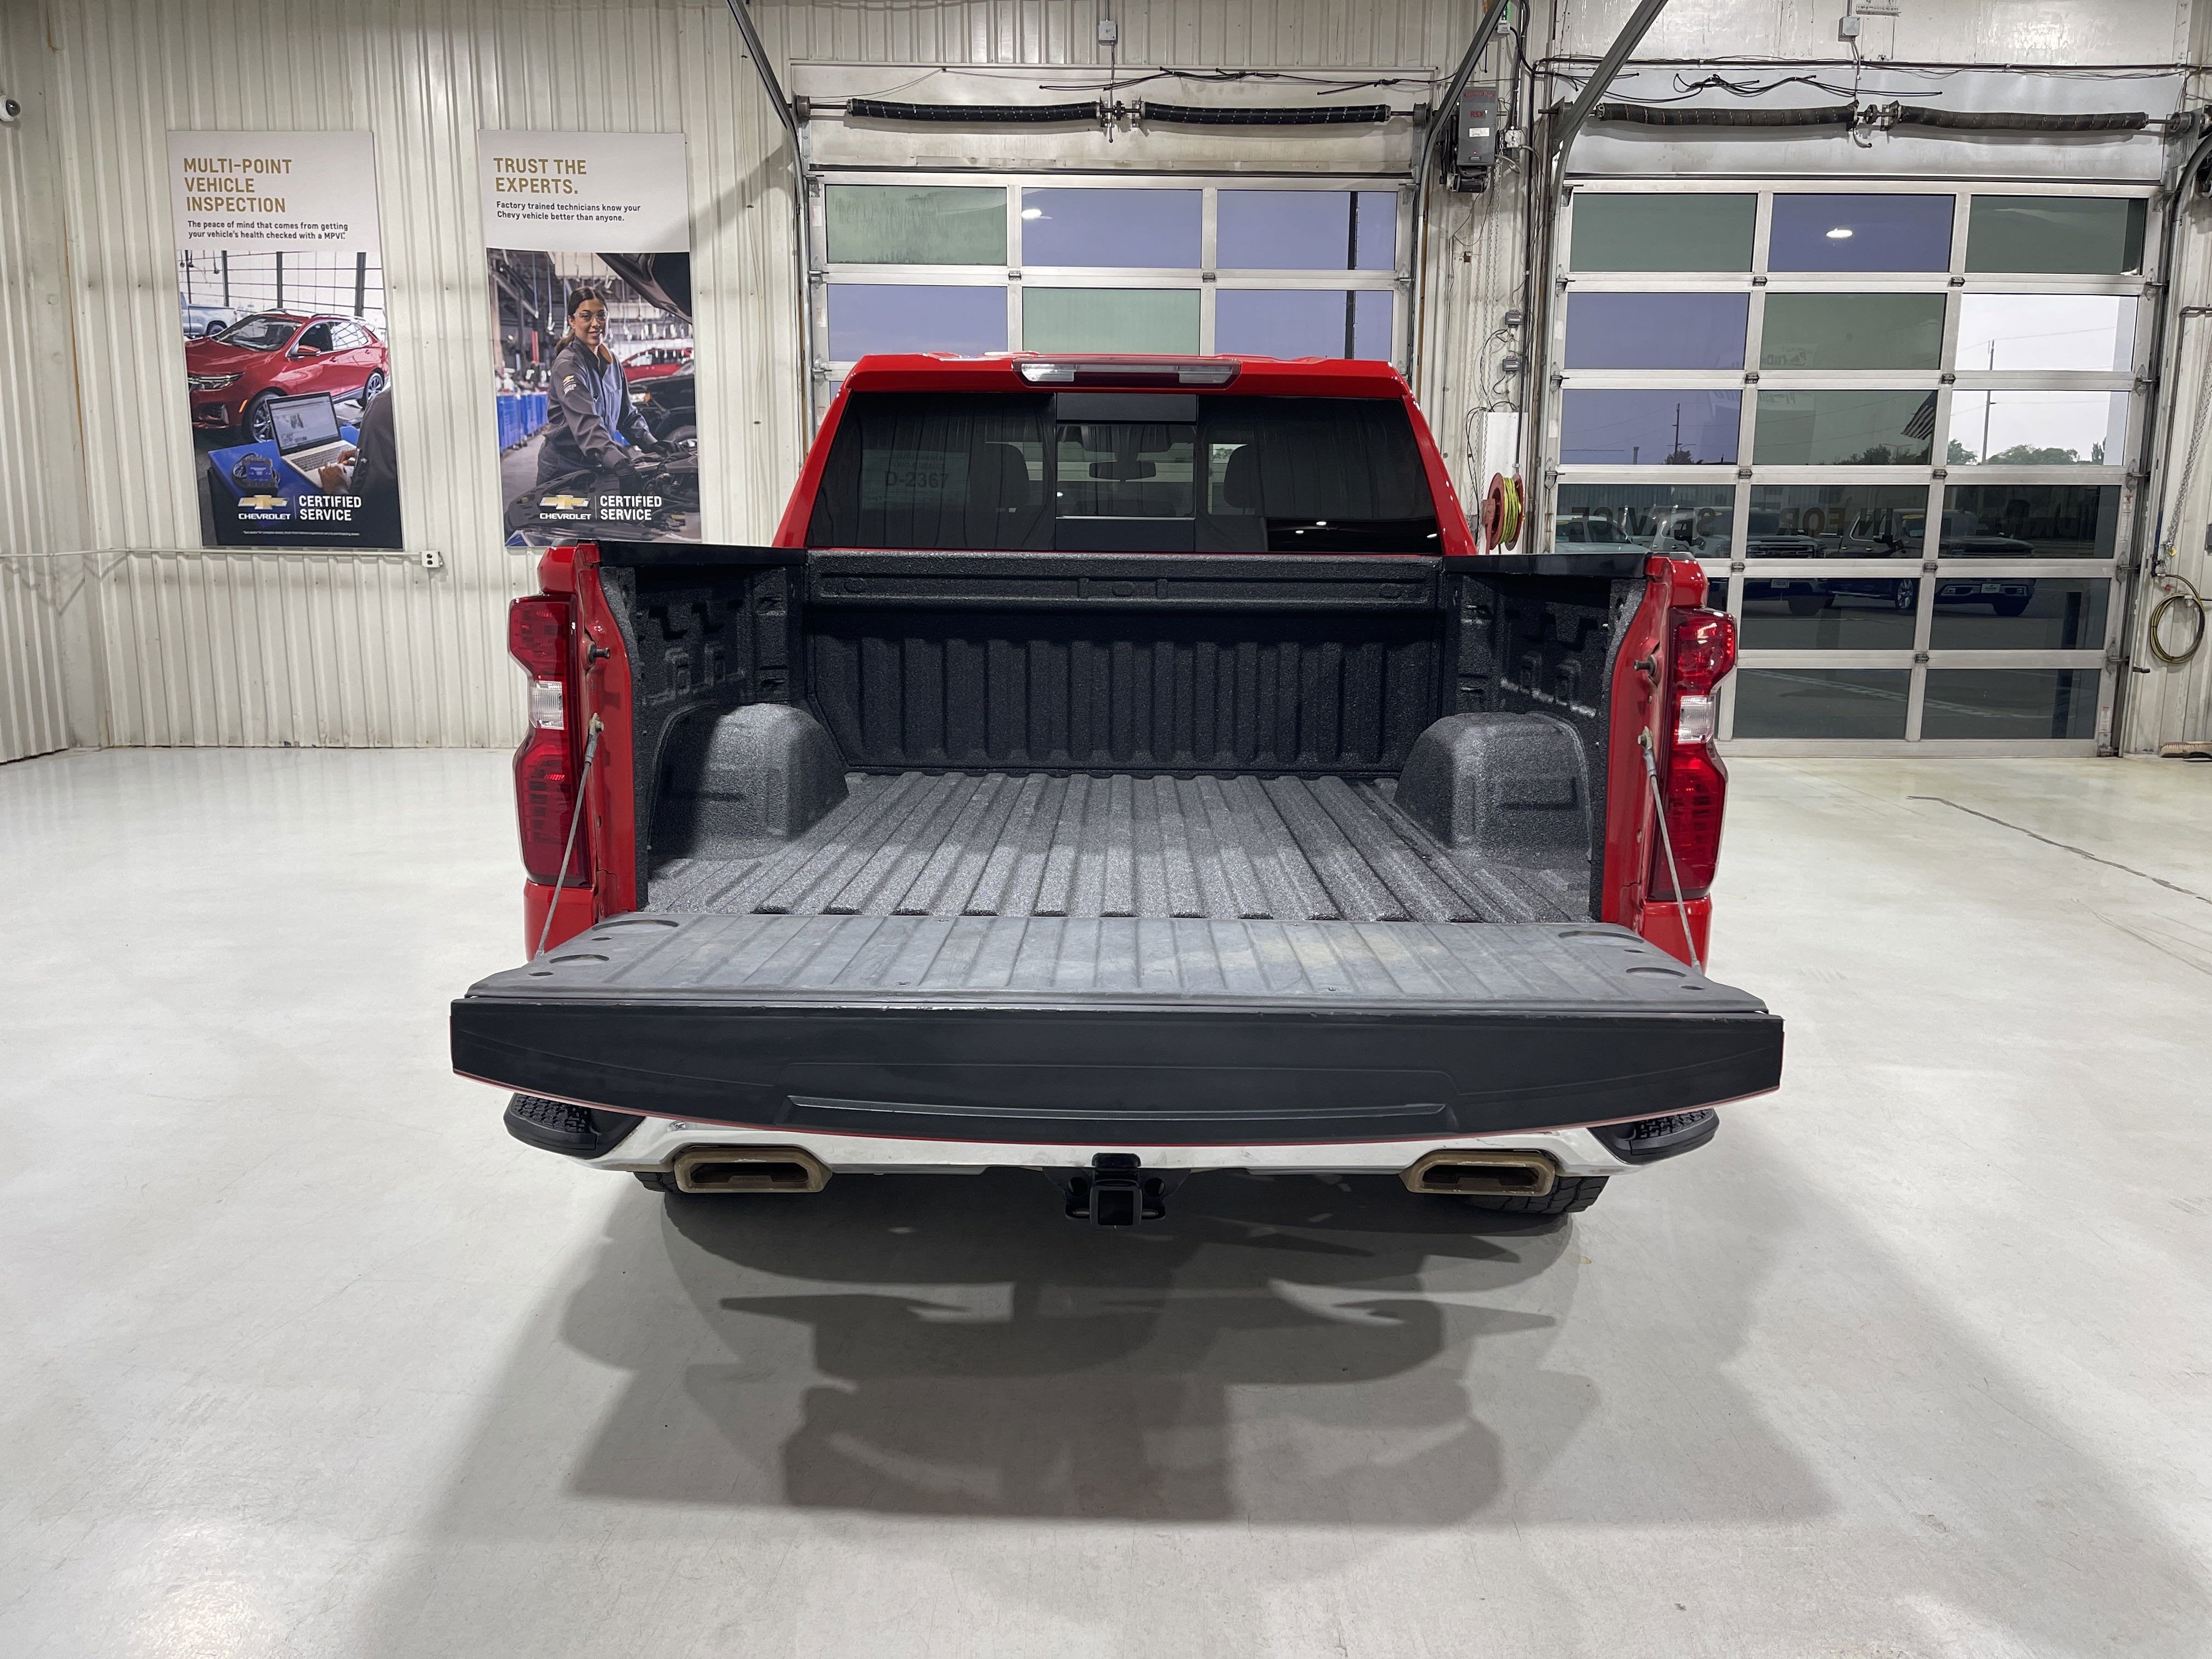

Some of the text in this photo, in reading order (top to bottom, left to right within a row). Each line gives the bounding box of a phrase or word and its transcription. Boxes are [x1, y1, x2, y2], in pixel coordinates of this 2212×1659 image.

[184, 157, 292, 174] MULTI-POINT
[493, 157, 586, 175] TRUST THE
[184, 177, 255, 193] VEHICLE
[495, 177, 578, 194] EXPERTS.
[187, 196, 286, 213] INSPECTION
[496, 201, 526, 211] Factory
[528, 202, 555, 210] trained
[497, 211, 520, 220] Chevy
[551, 212, 574, 221] better
[321, 222, 348, 231] getting
[207, 230, 239, 238] vehicle's
[241, 230, 264, 239] health
[885, 471, 950, 488] D-2367
[298, 495, 362, 508] CERTIFIED
[600, 495, 662, 507] CERTIFIED
[300, 509, 352, 521] SERVICE
[600, 509, 652, 521] SERVICE
